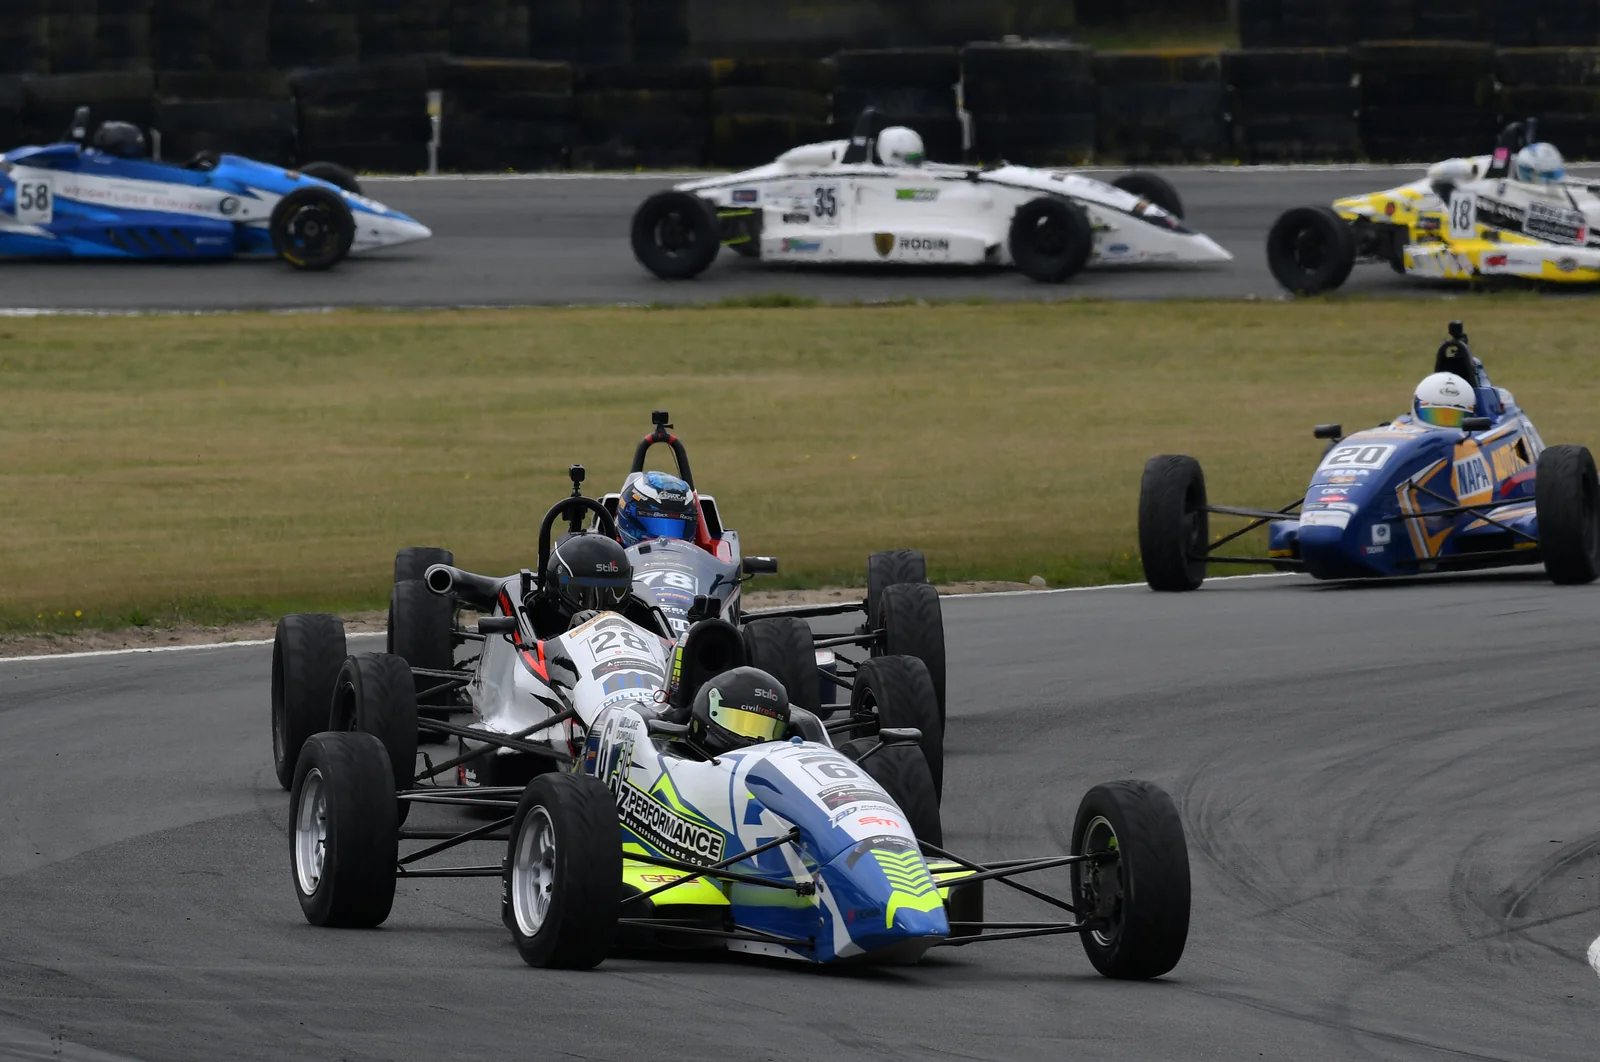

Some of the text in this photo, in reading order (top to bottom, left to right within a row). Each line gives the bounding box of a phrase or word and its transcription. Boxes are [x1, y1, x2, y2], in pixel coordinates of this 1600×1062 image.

[20, 183, 48, 211] 58
[814, 187, 836, 218] 35
[1452, 199, 1471, 231] 18
[900, 238, 949, 250] RODIN
[1328, 446, 1388, 465] 20
[1456, 458, 1491, 496] NAPA
[596, 561, 619, 573] Stilo
[633, 571, 694, 590] 78
[591, 631, 650, 654] 28
[754, 688, 779, 702] Stilo
[625, 718, 640, 730] BLAKE
[818, 763, 859, 778] 6
